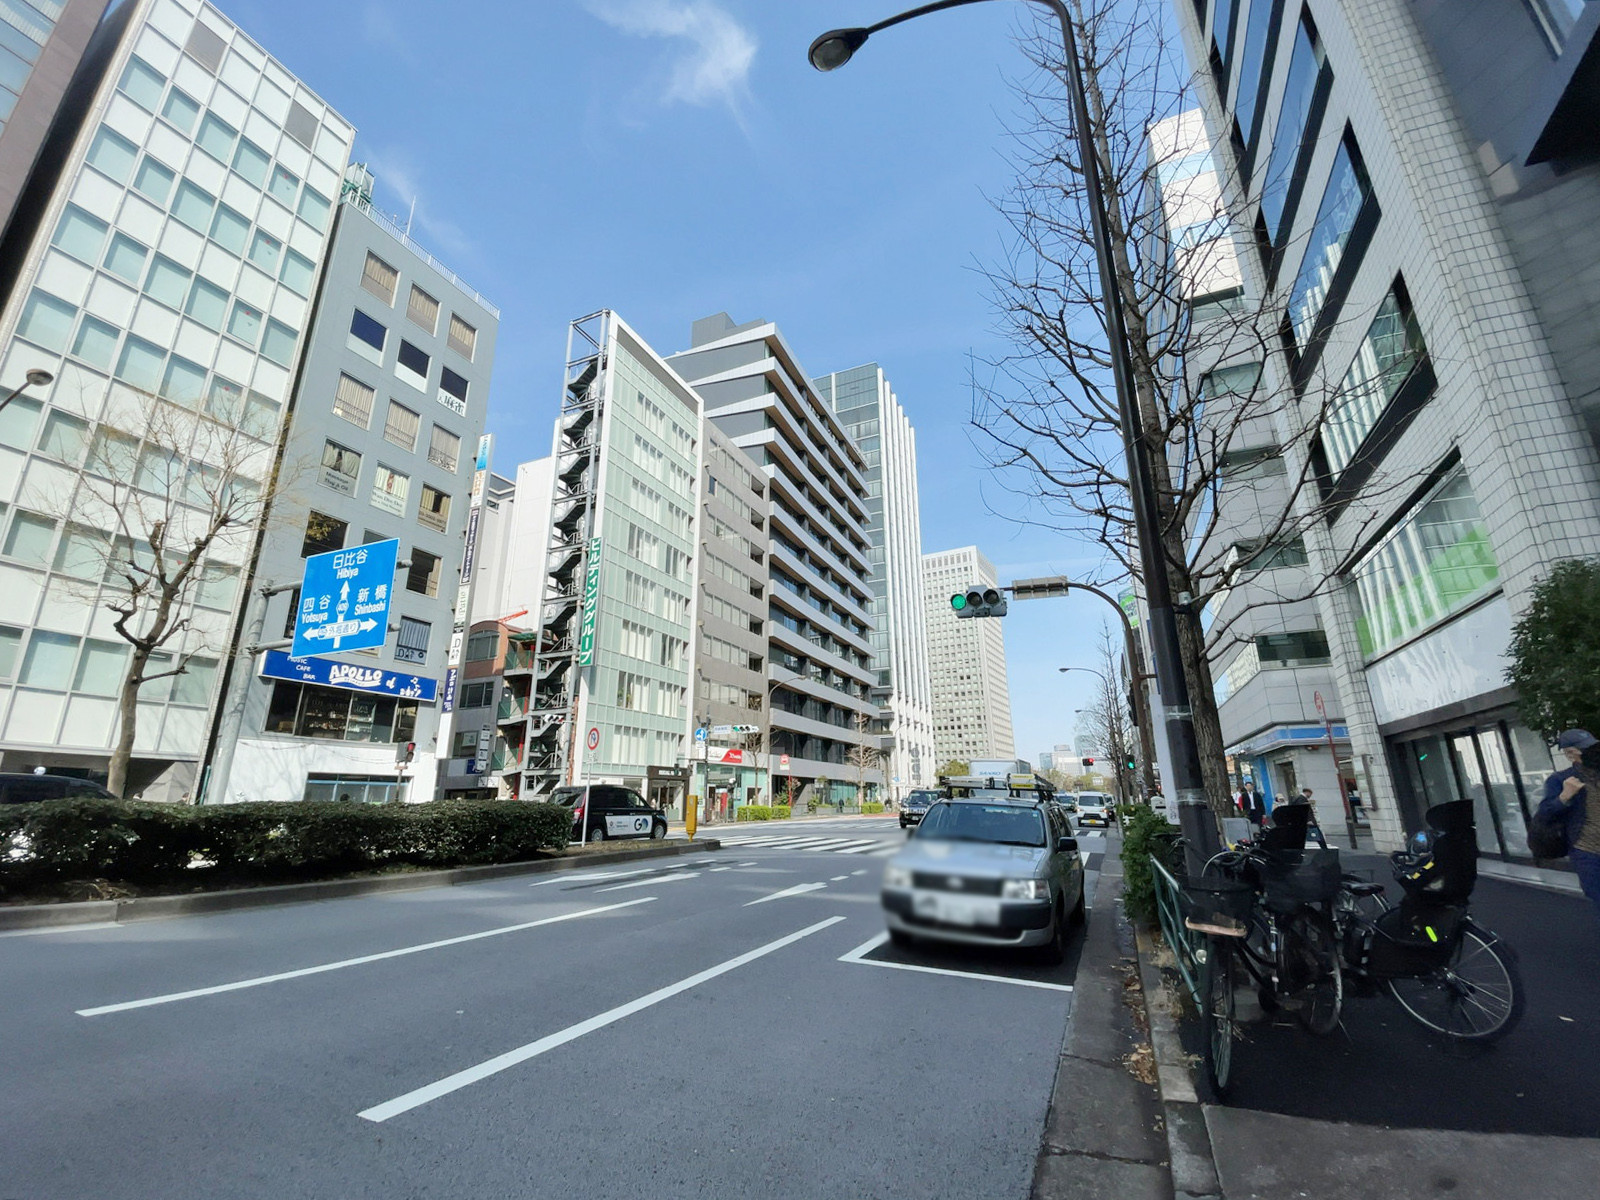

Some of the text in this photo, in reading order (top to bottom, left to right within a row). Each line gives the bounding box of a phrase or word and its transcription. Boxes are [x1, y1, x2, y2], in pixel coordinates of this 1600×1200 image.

[333, 549, 368, 569] 日比谷
[336, 568, 359, 579] Hibiya
[357, 584, 387, 602] 新橋
[580, 540, 600, 663] ビルディンググループ
[303, 595, 331, 612] 四谷
[354, 600, 386, 615] Shinbashi
[302, 612, 328, 624] Yotsuya
[329, 665, 383, 682] APOLLO
